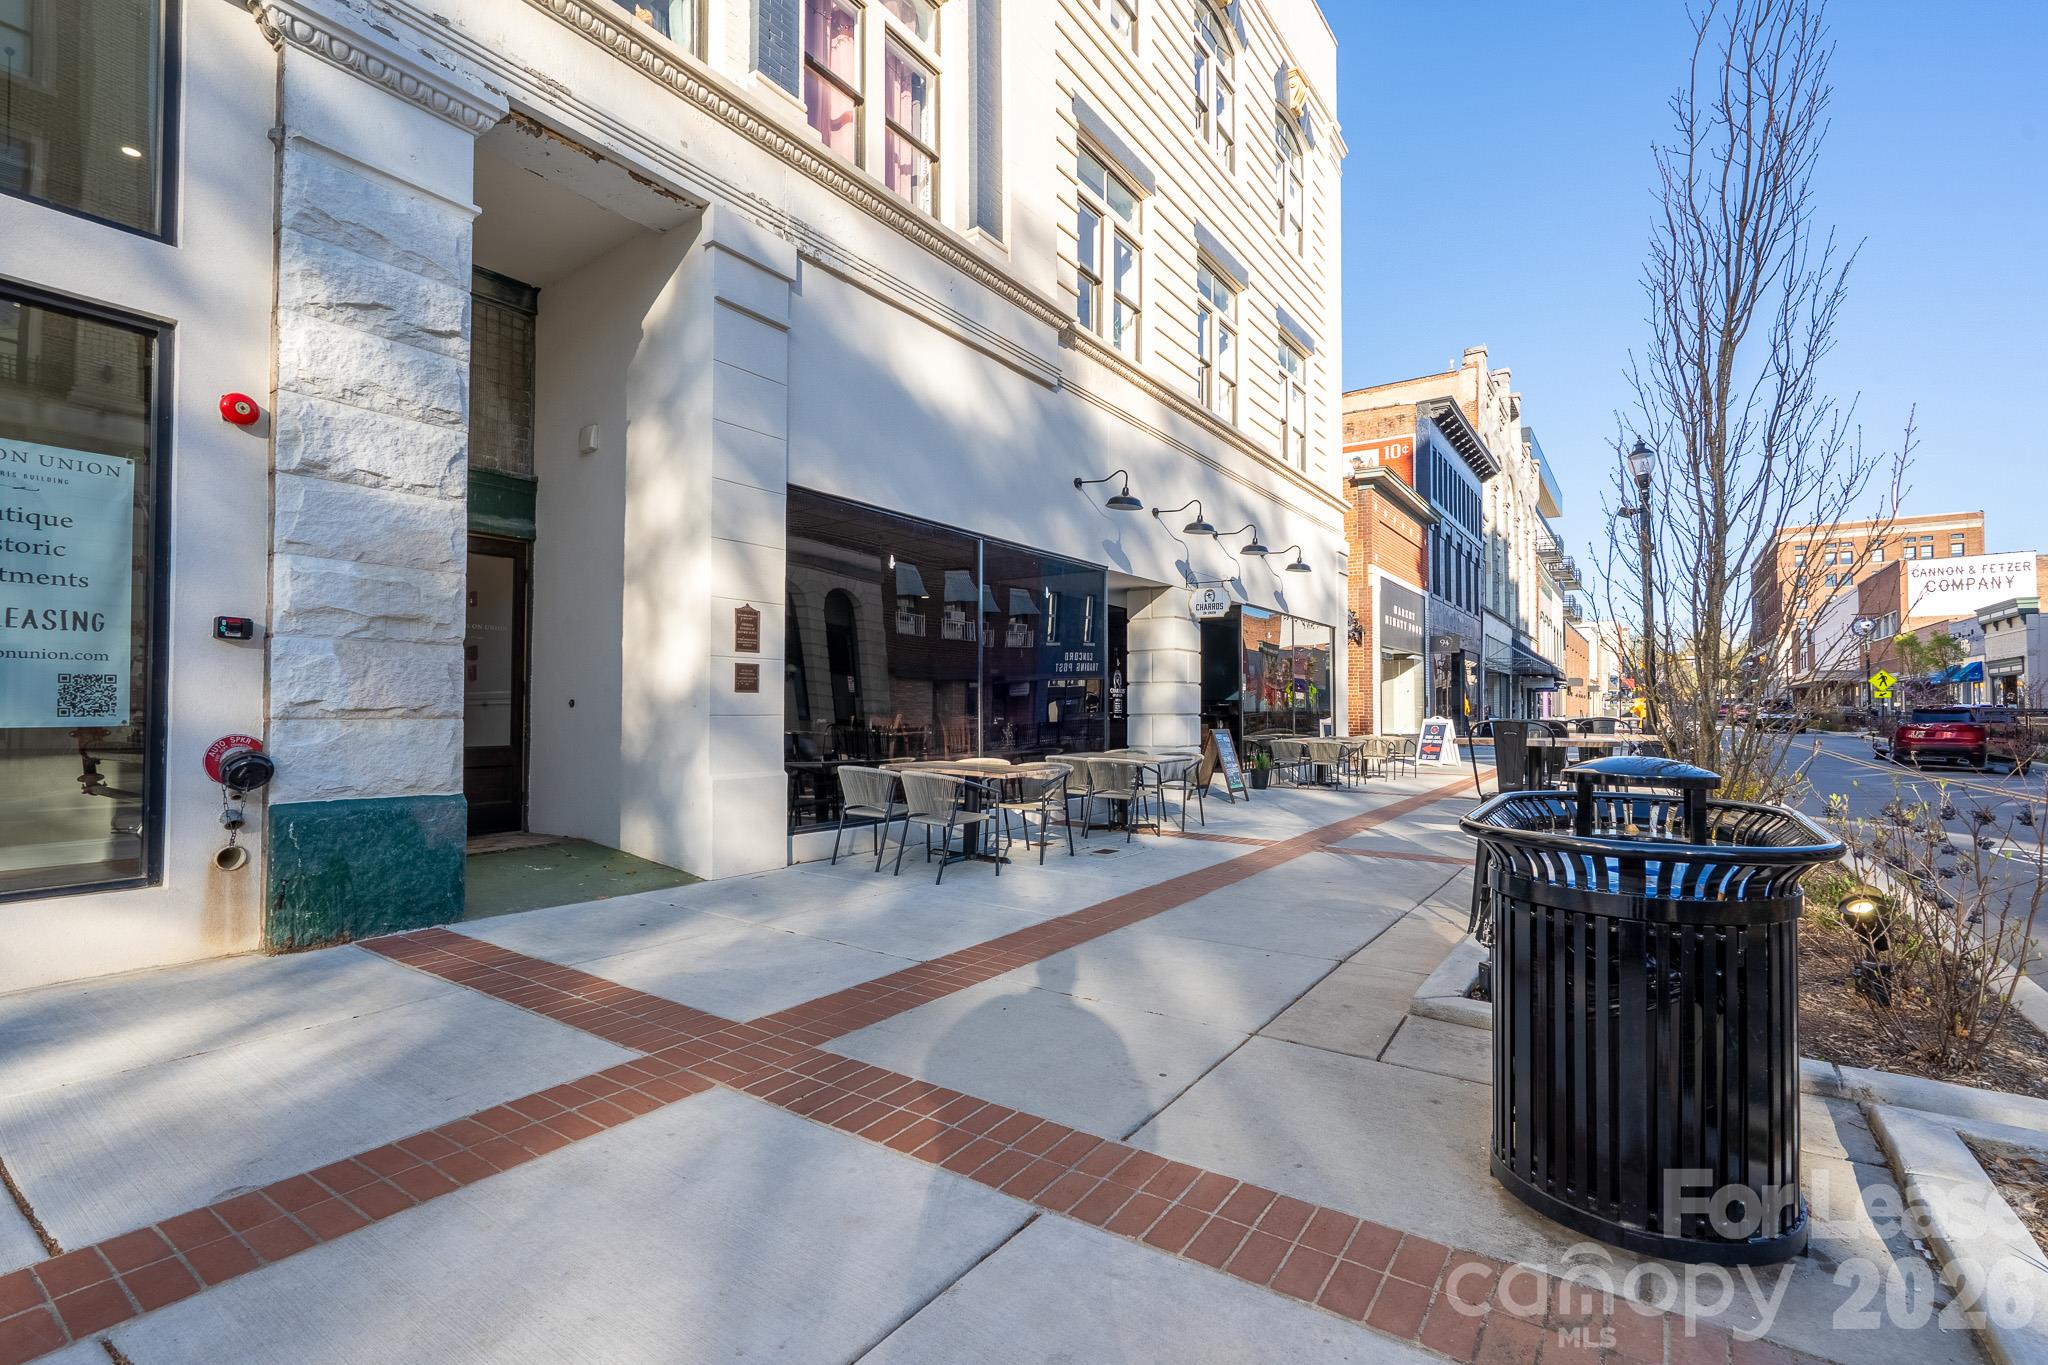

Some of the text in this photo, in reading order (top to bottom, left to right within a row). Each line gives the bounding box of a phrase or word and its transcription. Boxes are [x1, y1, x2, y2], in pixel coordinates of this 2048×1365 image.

[1384, 444, 1409, 460] 10¢
[39, 455, 121, 478] UNION
[23, 473, 69, 485] BUILDING
[0, 507, 74, 531] tique
[0, 537, 67, 557] toric
[1911, 561, 2032, 578] CANNON & FETZER
[1926, 575, 2015, 592] COMPANY
[1195, 602, 1224, 611] CHARROS
[0, 607, 105, 633] EASING
[208, 740, 226, 757] AUTO
[230, 736, 252, 745] SPKR
